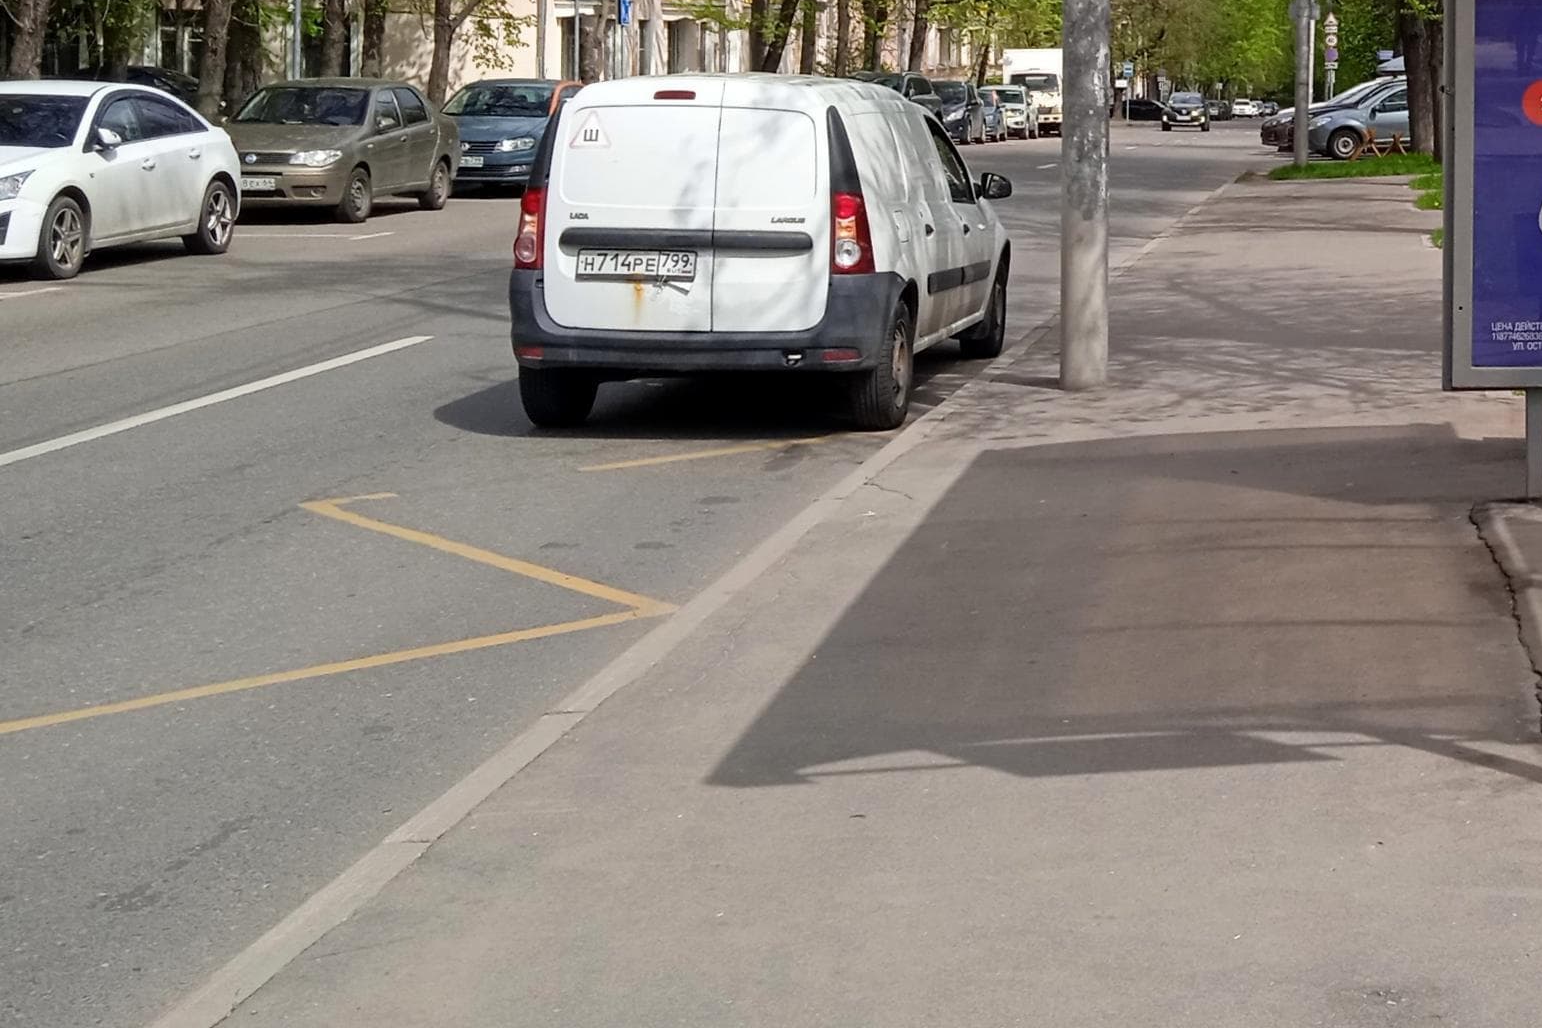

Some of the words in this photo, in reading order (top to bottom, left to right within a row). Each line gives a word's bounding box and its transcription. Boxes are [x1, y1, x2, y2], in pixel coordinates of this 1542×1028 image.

[583, 129, 599, 143] Ш
[569, 212, 589, 220] LADA
[662, 253, 690, 268] 799
[1491, 322, 1513, 332] ЦЕНА
